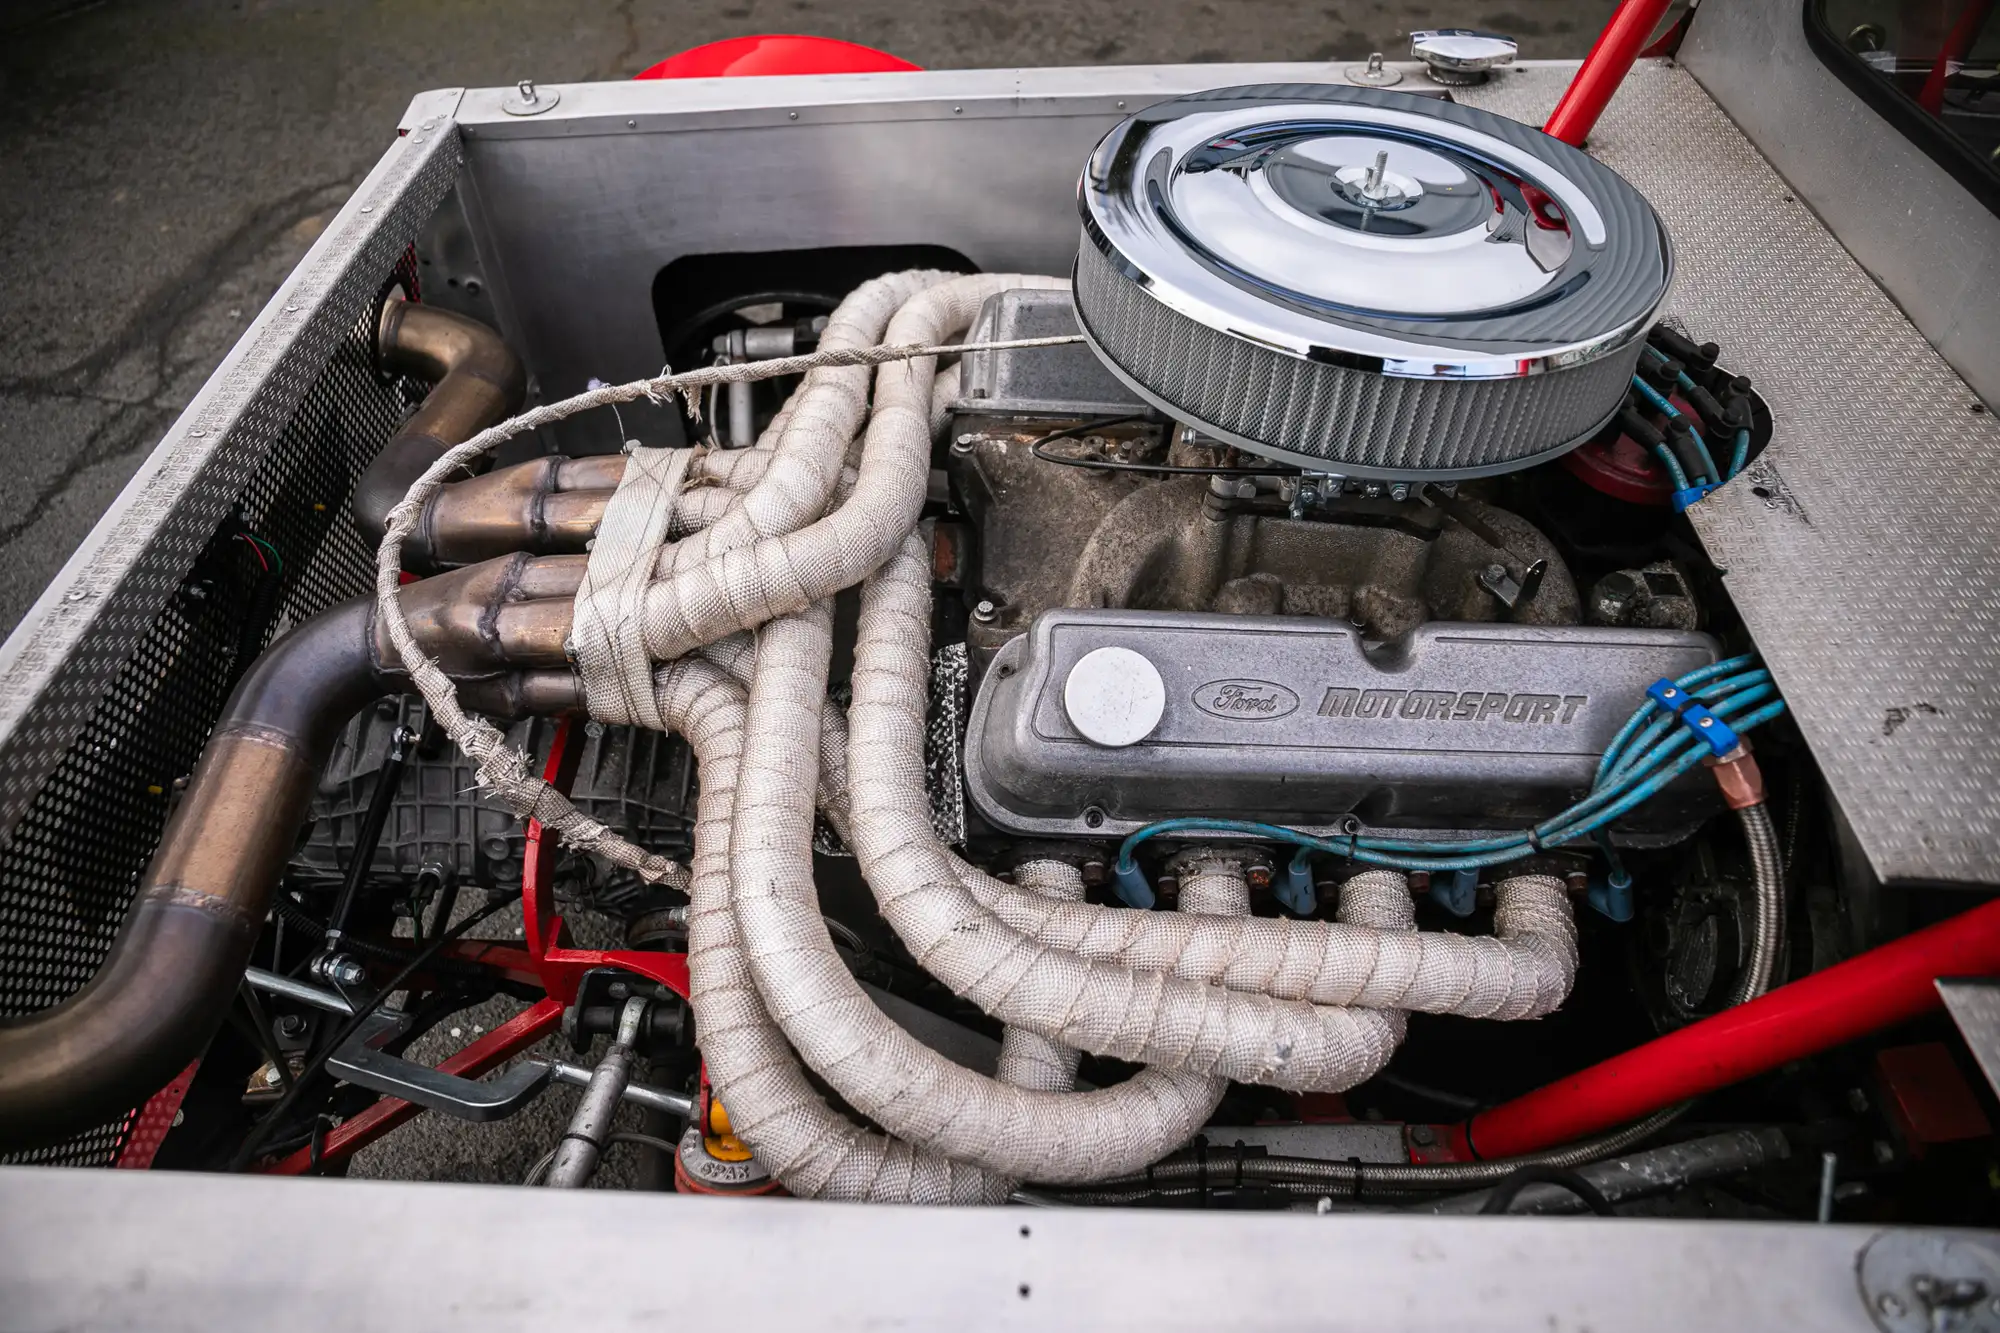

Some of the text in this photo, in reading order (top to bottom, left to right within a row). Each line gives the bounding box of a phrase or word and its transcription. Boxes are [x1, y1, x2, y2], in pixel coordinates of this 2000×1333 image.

[1212, 684, 1588, 725] Ford MOTORSPORT
[701, 1162, 750, 1180] SPAX
